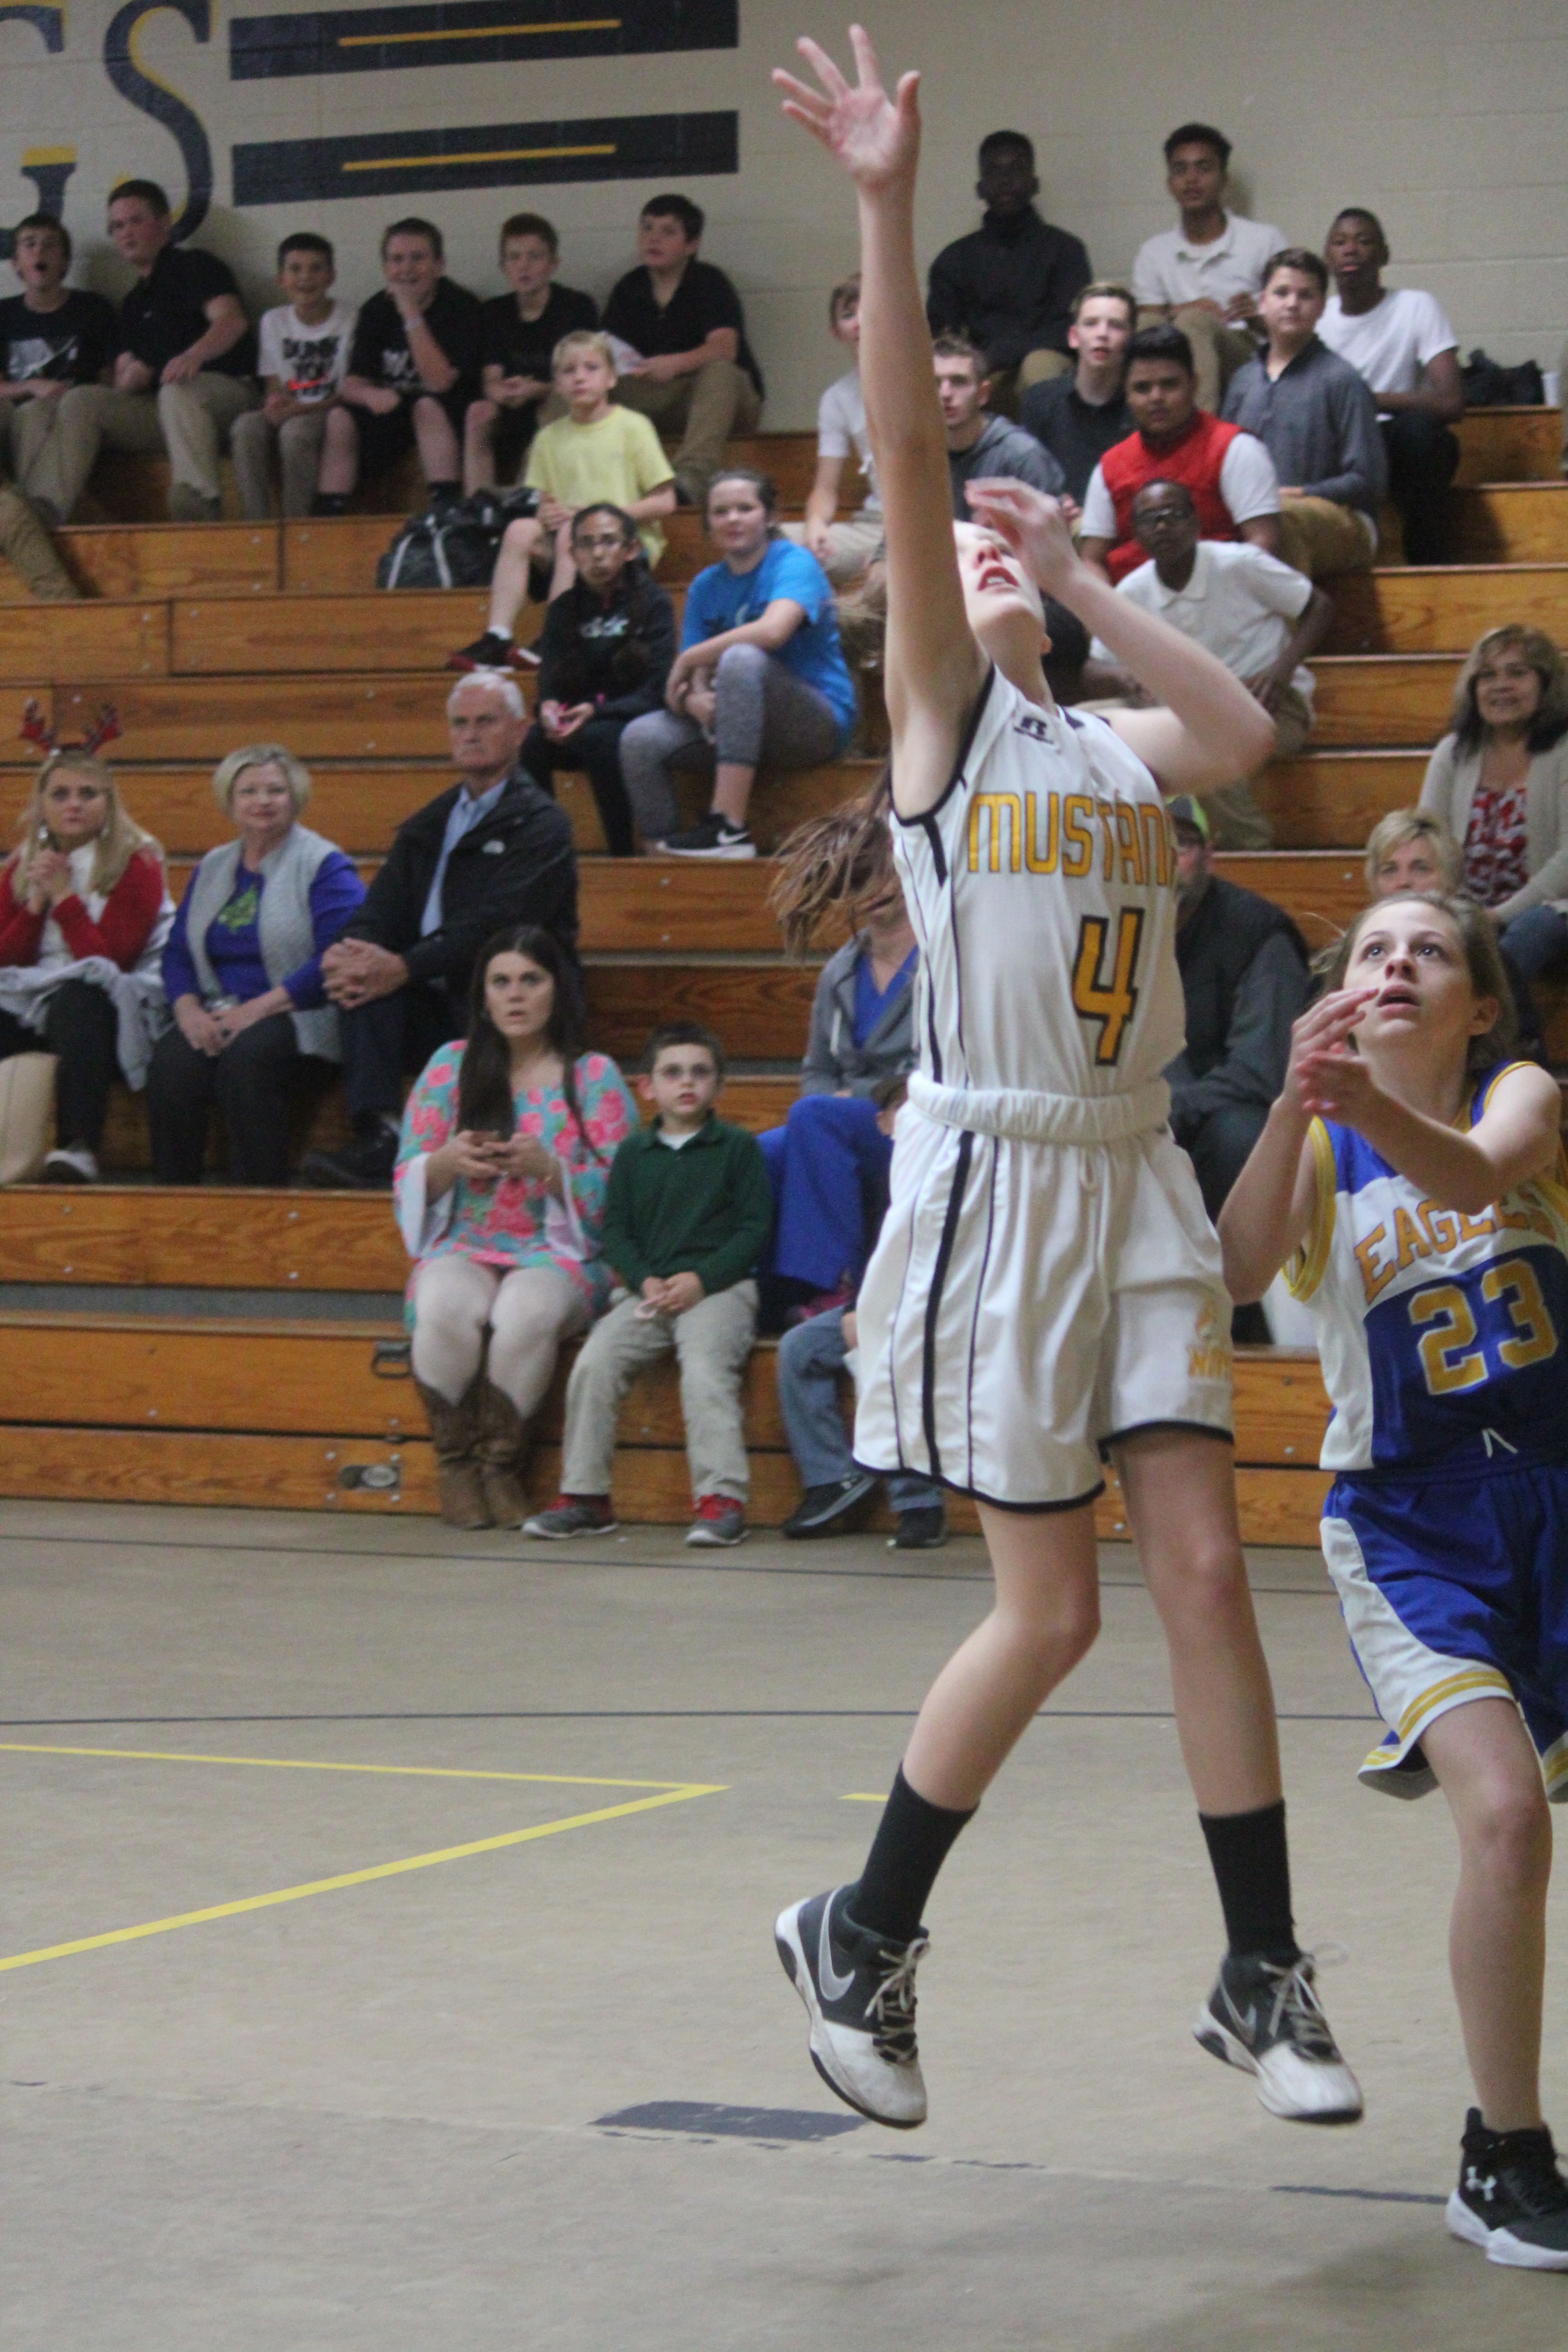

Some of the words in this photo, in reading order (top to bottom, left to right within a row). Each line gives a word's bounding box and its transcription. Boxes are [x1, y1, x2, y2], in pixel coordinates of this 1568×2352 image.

[0, 0, 222, 260] S
[967, 790, 1178, 889] MUSTAN
[1071, 906, 1146, 1066] 4
[1408, 1258, 1558, 1396] 23
